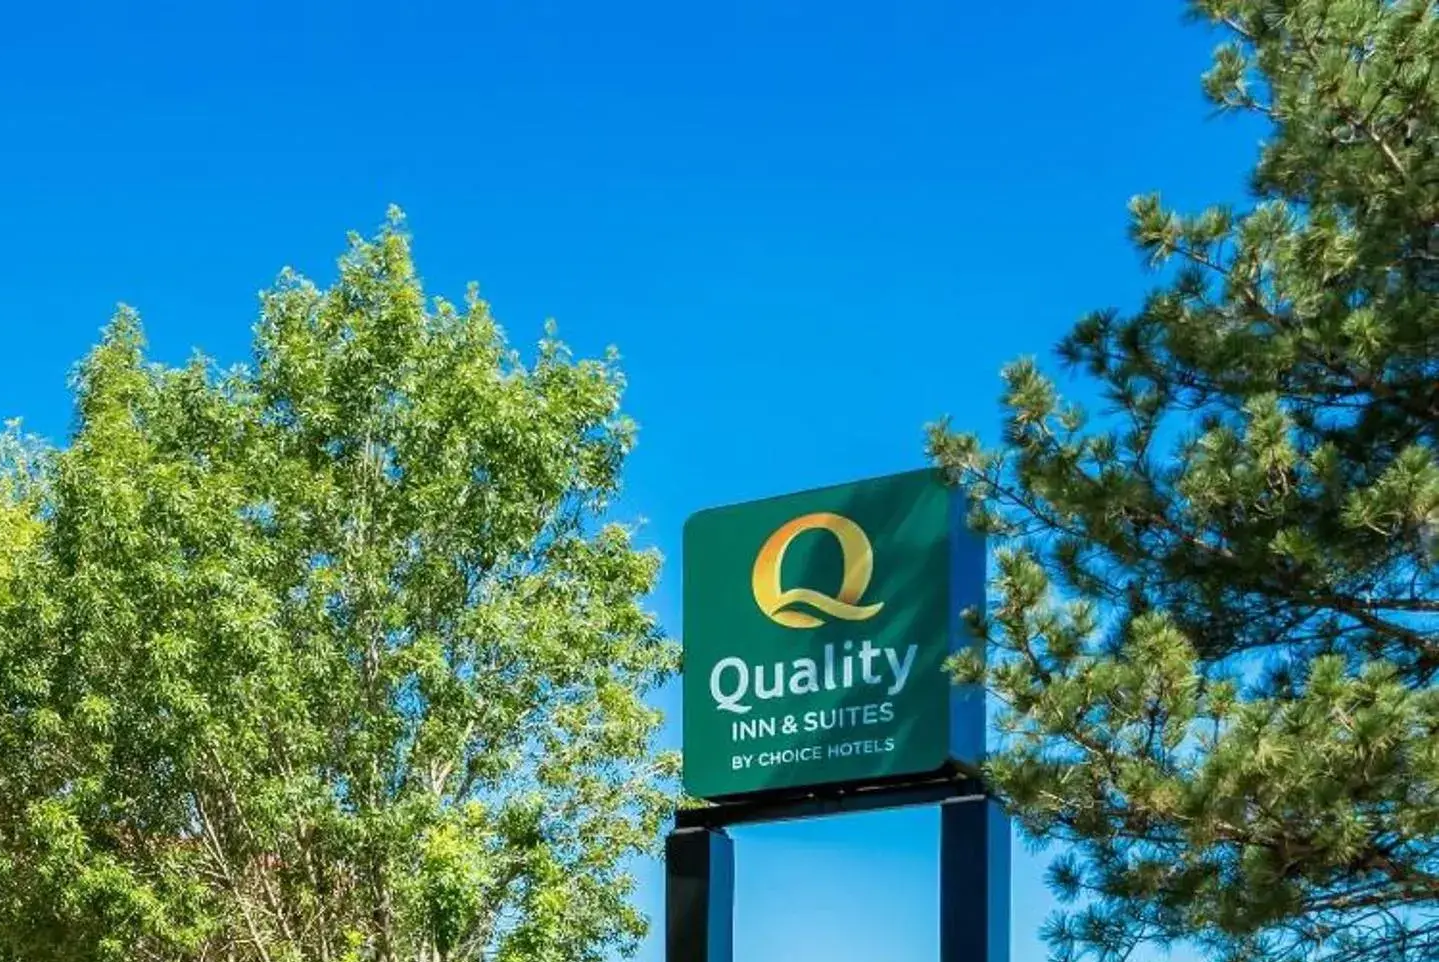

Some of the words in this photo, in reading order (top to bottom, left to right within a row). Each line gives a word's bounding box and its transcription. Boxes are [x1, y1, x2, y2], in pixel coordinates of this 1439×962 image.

[752, 512, 885, 628] Q
[710, 640, 918, 714] Quality
[732, 717, 776, 742] INN
[781, 714, 799, 735] &
[803, 702, 895, 732] SUITES
[731, 755, 753, 770] BY
[758, 745, 823, 768] CHOICE
[827, 738, 895, 758] HOTELS
